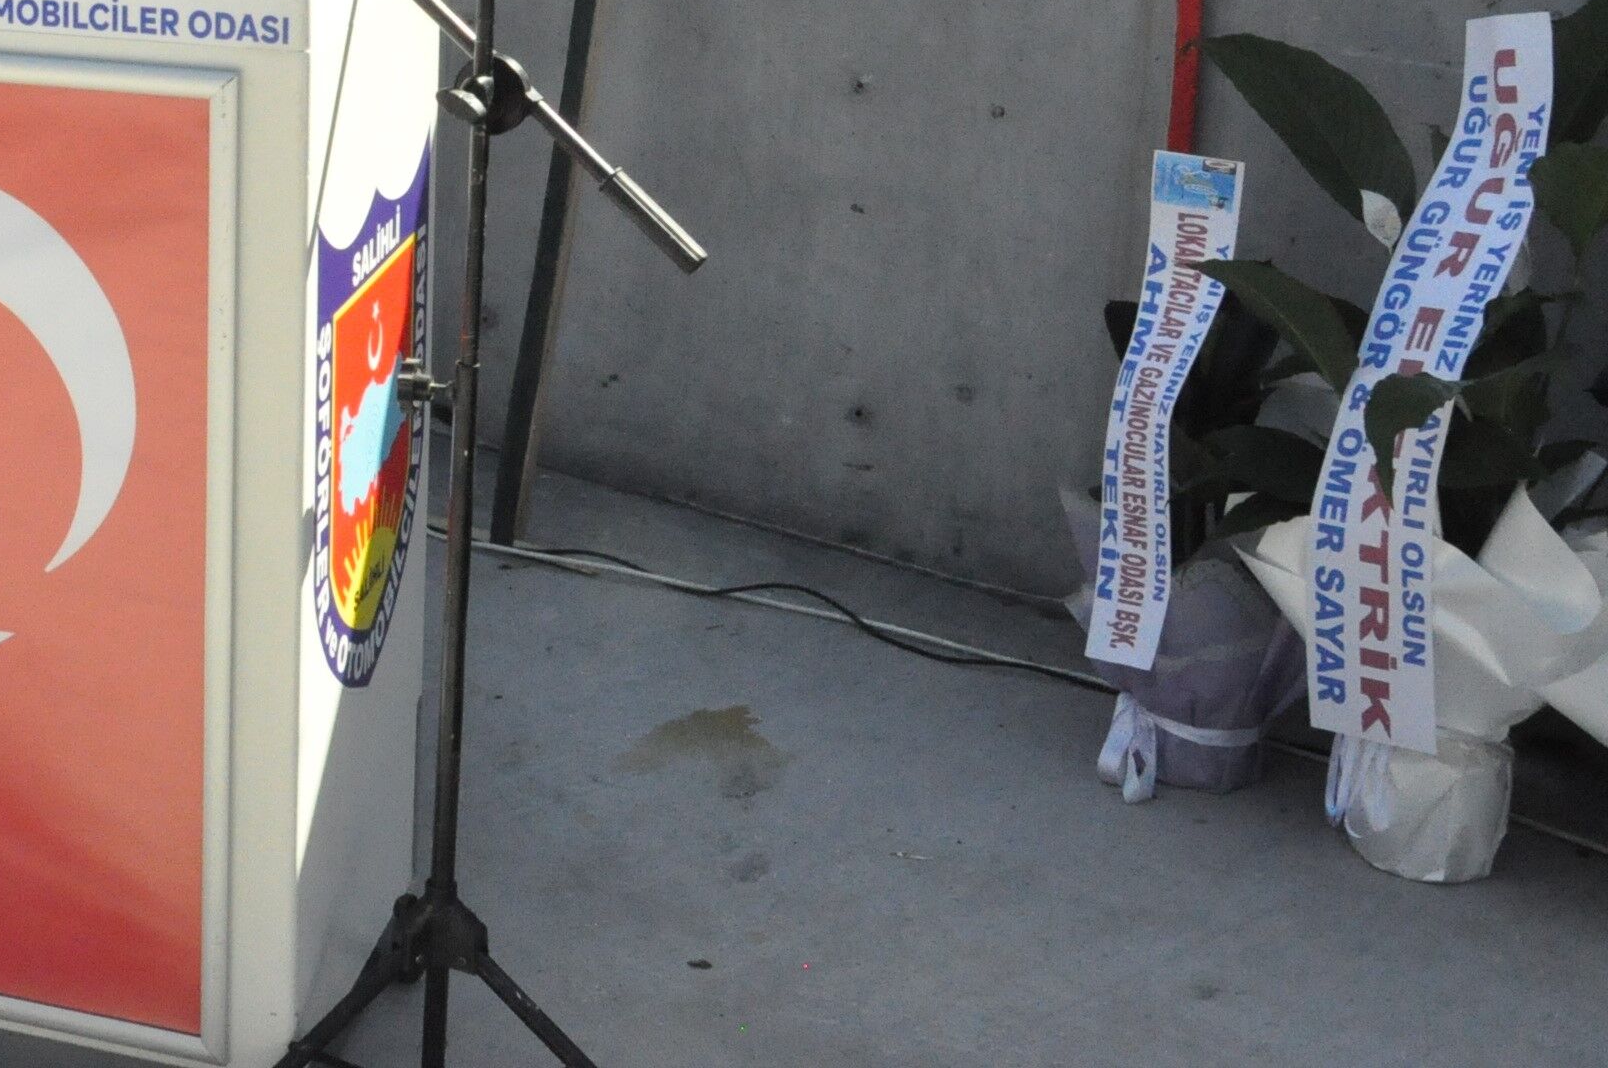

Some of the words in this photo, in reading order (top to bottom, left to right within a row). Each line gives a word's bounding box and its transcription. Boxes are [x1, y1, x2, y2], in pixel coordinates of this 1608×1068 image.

[188, 12, 290, 45] ODASI
[1433, 48, 1518, 278] UĞUR
[1438, 75, 1492, 189] UĞUR
[353, 204, 401, 287] SALİHLİ
[1496, 200, 1531, 232] İŞ
[1110, 242, 1167, 422] AHMET
[1361, 201, 1452, 369] GÜNGÖR
[1435, 242, 1511, 372] YERİNİZ
[1145, 342, 1176, 365] VE
[1158, 332, 1202, 416] YERİNİZ
[1122, 366, 1163, 489] GAZİNOCULAR
[1154, 423, 1167, 516] HAYIRLI
[1402, 414, 1441, 530] AYIRLI
[315, 322, 332, 628] ŞOFÖRLER
[325, 615, 338, 659] ve
[1096, 440, 1120, 601] TEKİN
[1122, 491, 1147, 549] ESNAF
[1315, 428, 1366, 552] ÖMER
[1115, 553, 1147, 608] ODASI
[1152, 522, 1167, 602] OLSUN
[1400, 542, 1426, 667] OLSUN
[1315, 566, 1346, 705] SAYAR
